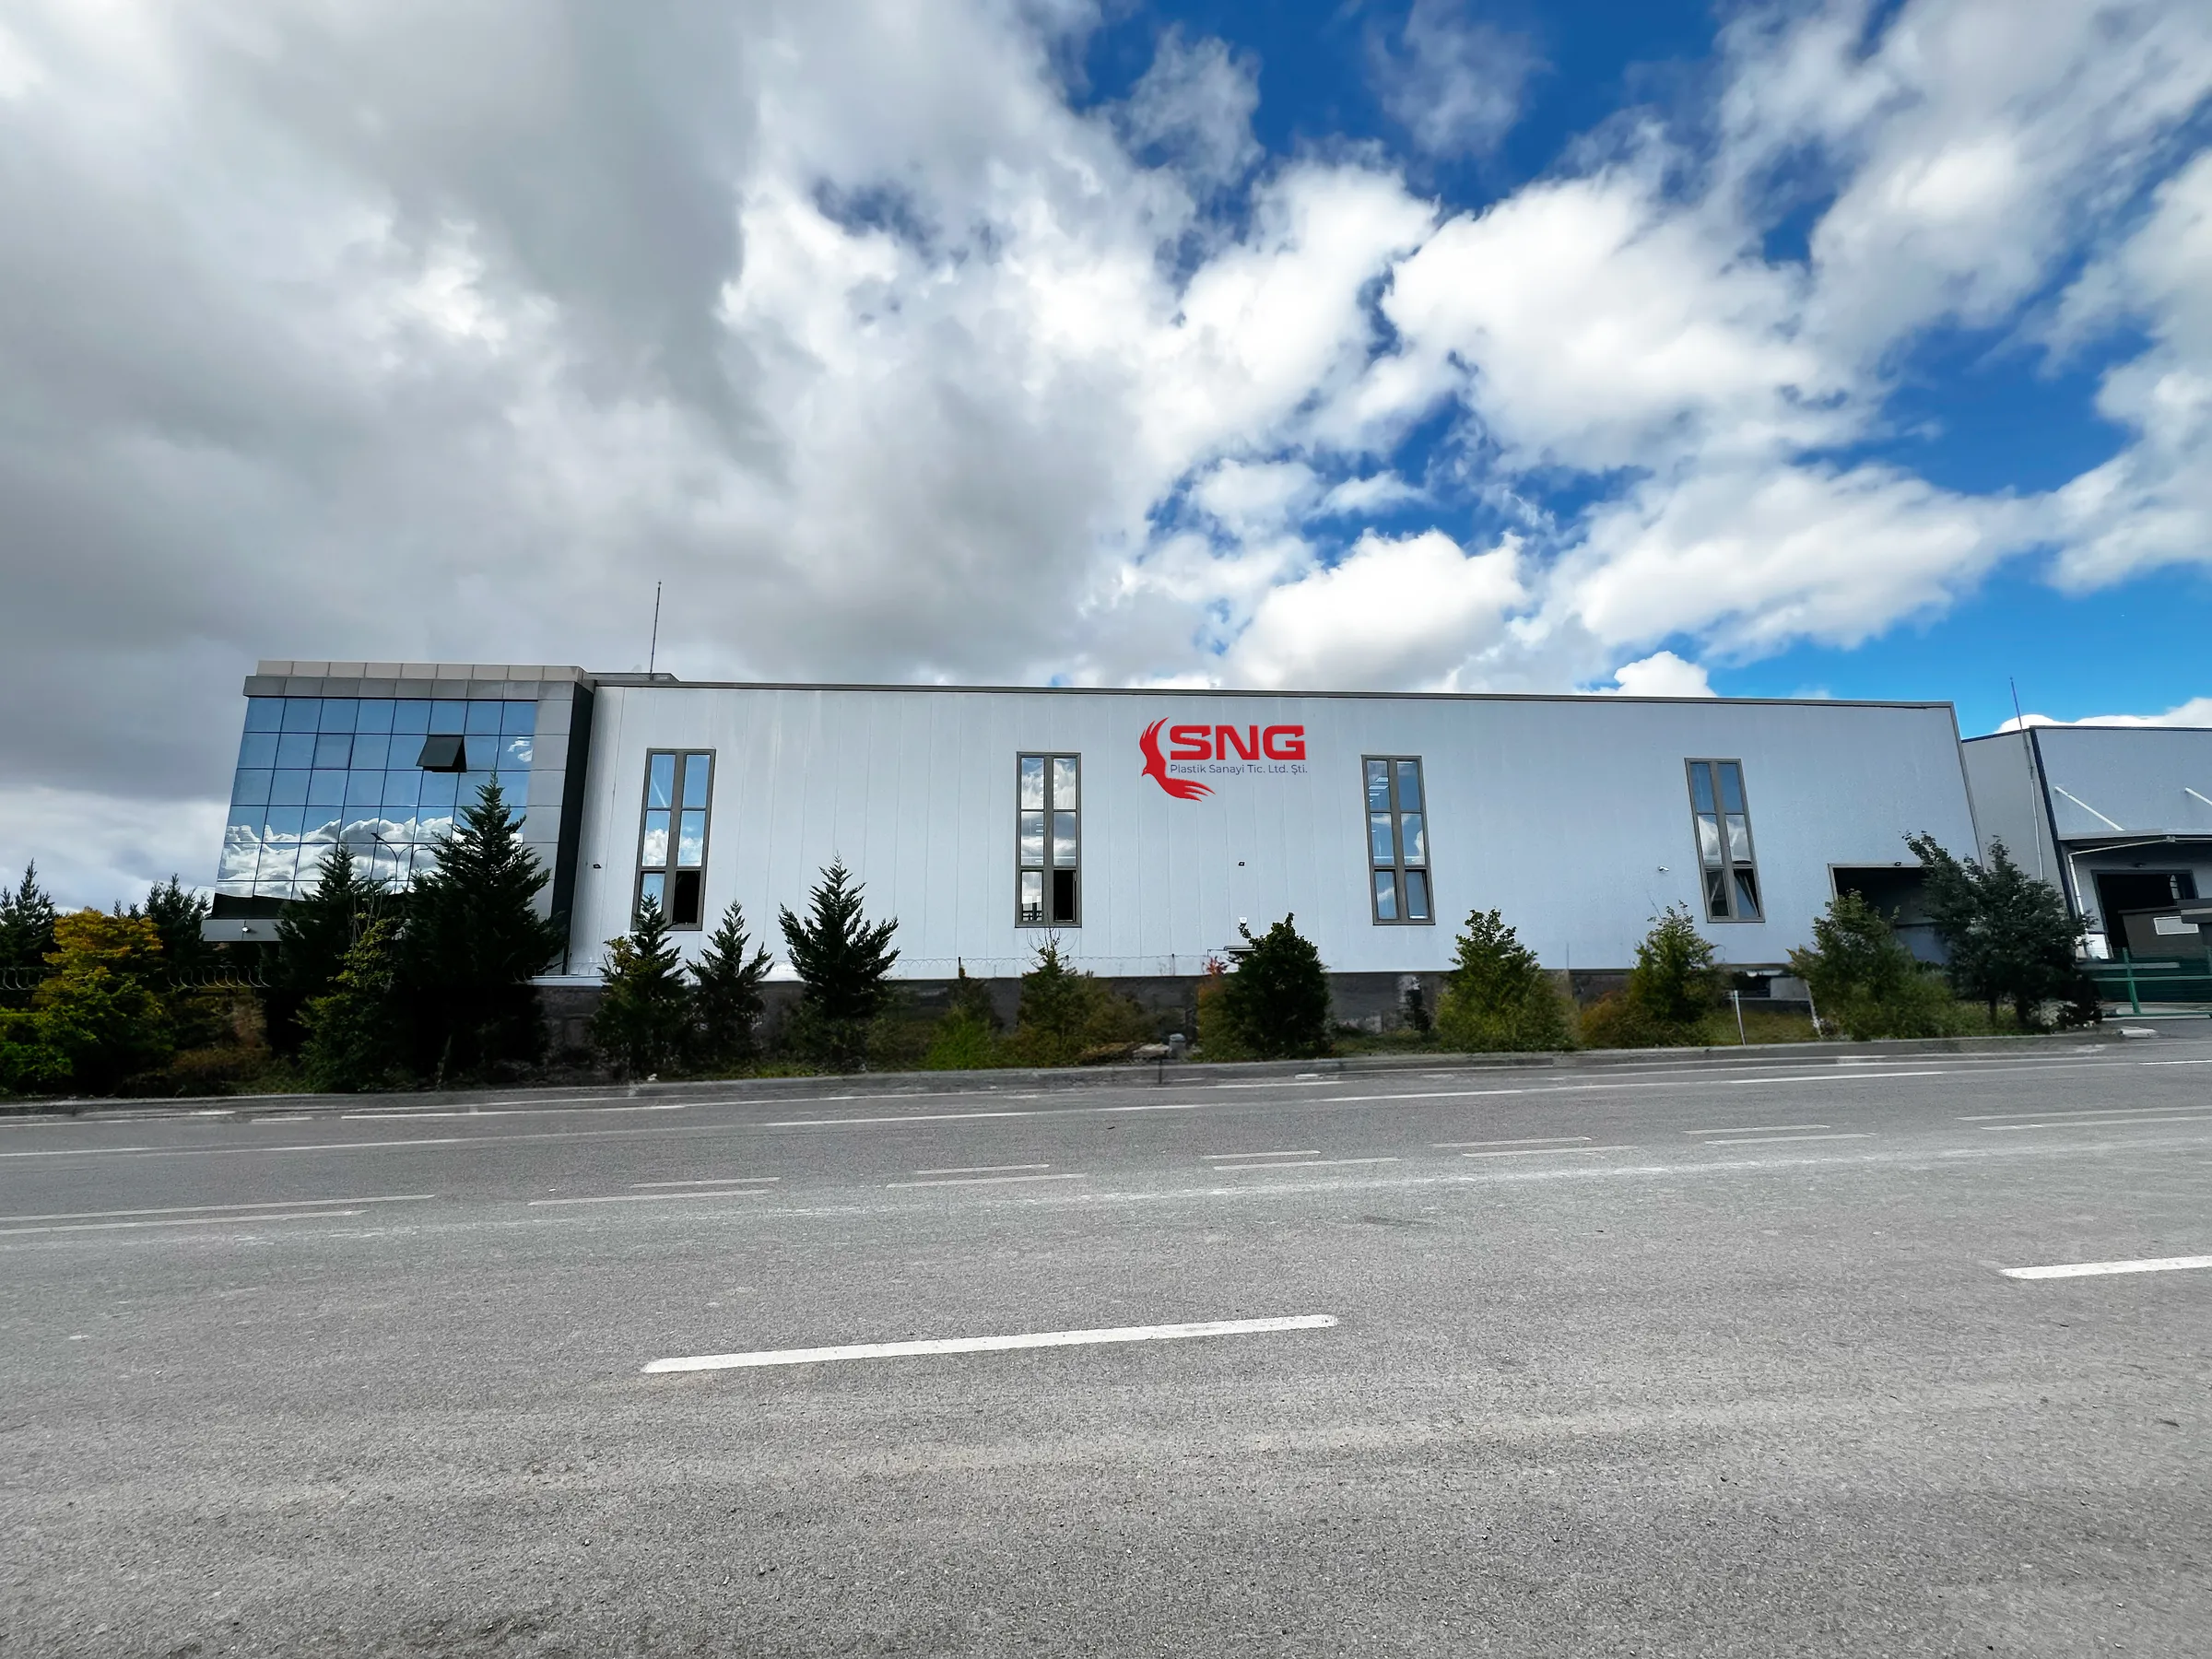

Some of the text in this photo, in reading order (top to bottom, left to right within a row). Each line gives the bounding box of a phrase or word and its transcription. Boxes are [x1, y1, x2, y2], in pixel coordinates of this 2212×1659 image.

[1170, 724, 1306, 760] SNG
[1170, 764, 1308, 775] Plastik Sanayi Tic. Ltd. Şti.
